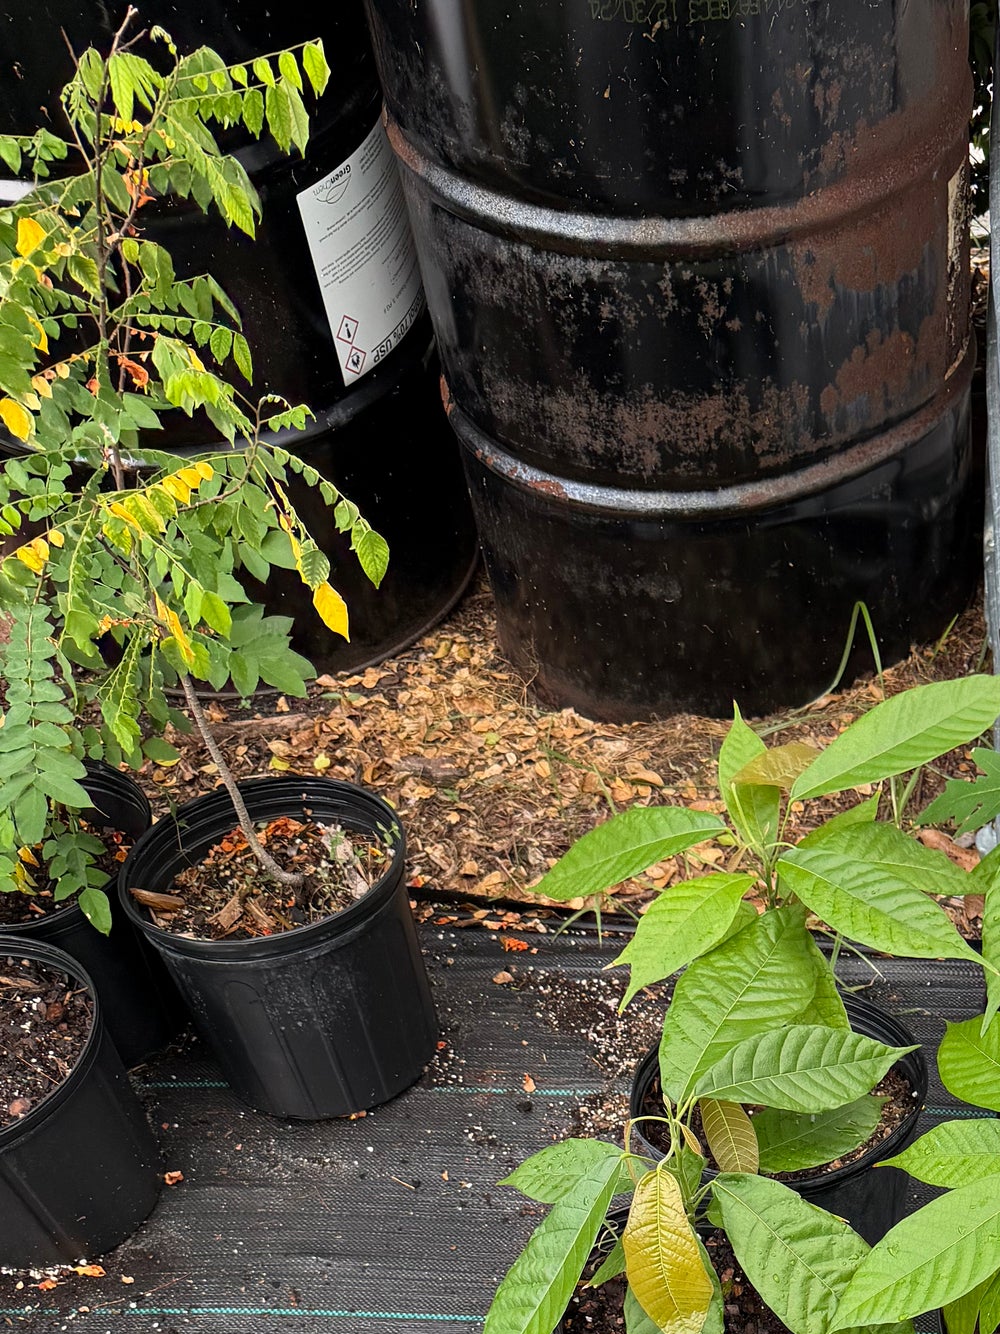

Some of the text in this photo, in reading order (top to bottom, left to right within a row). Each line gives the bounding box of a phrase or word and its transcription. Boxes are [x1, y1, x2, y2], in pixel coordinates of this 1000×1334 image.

[313, 164, 351, 196] GreenChem
[393, 319, 409, 343] 70%
[374, 339, 392, 363] USP
